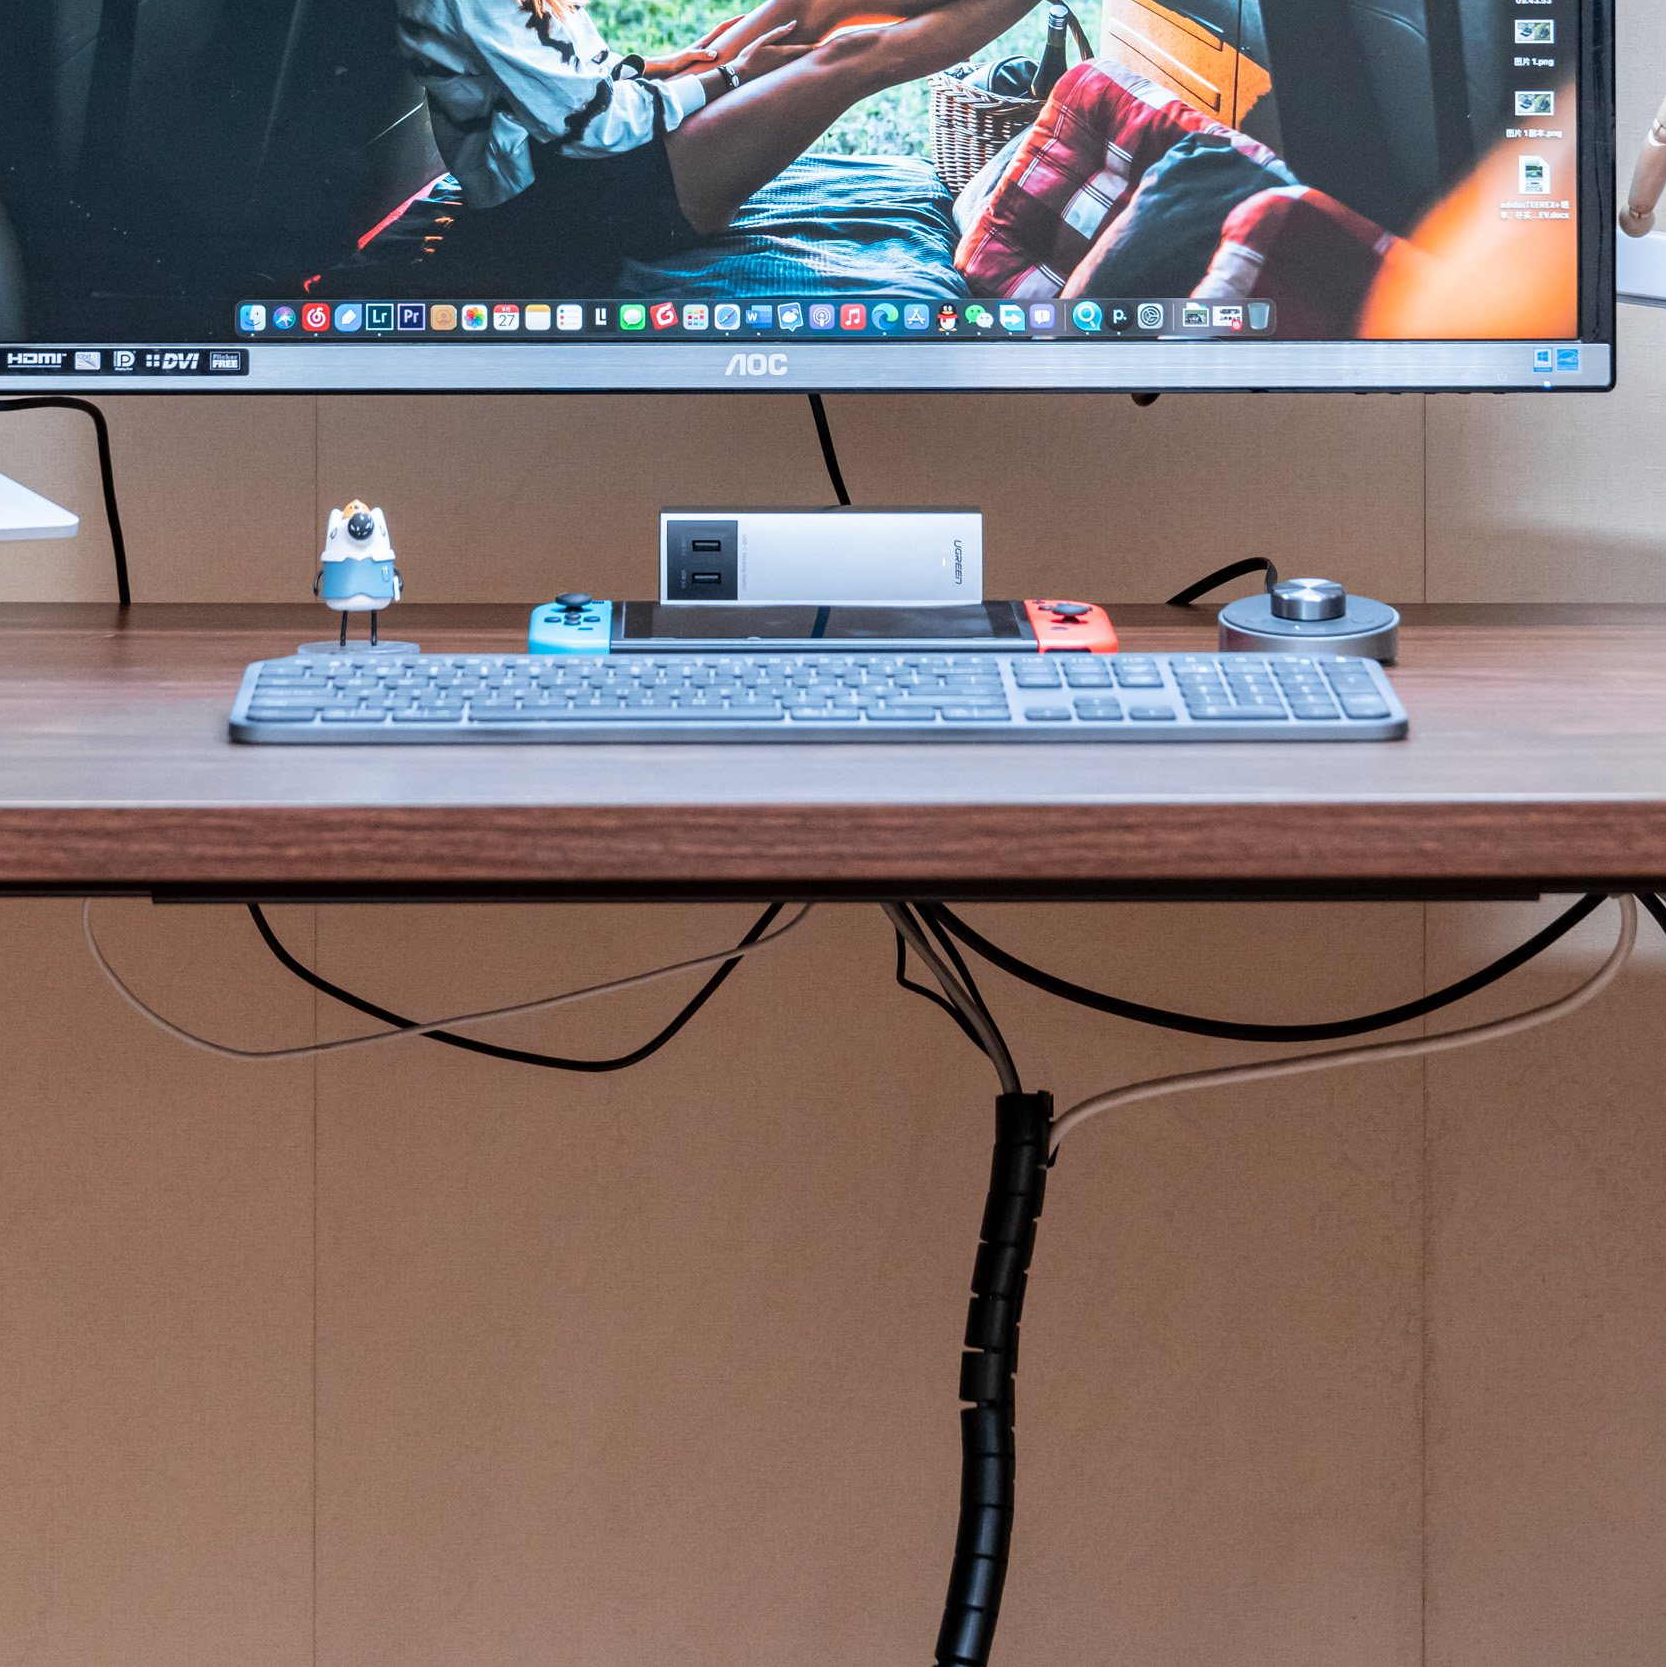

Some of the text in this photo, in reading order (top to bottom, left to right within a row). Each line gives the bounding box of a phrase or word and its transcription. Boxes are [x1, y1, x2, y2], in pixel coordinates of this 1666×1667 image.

[373, 310, 387, 323] Lr
[404, 310, 419, 323] Pr
[499, 314, 515, 327] 27
[7, 353, 62, 364] HDMI
[162, 353, 200, 370] DVI
[212, 359, 238, 368] FREE
[725, 353, 788, 376] AOC
[953, 539, 963, 585] UGREEN
